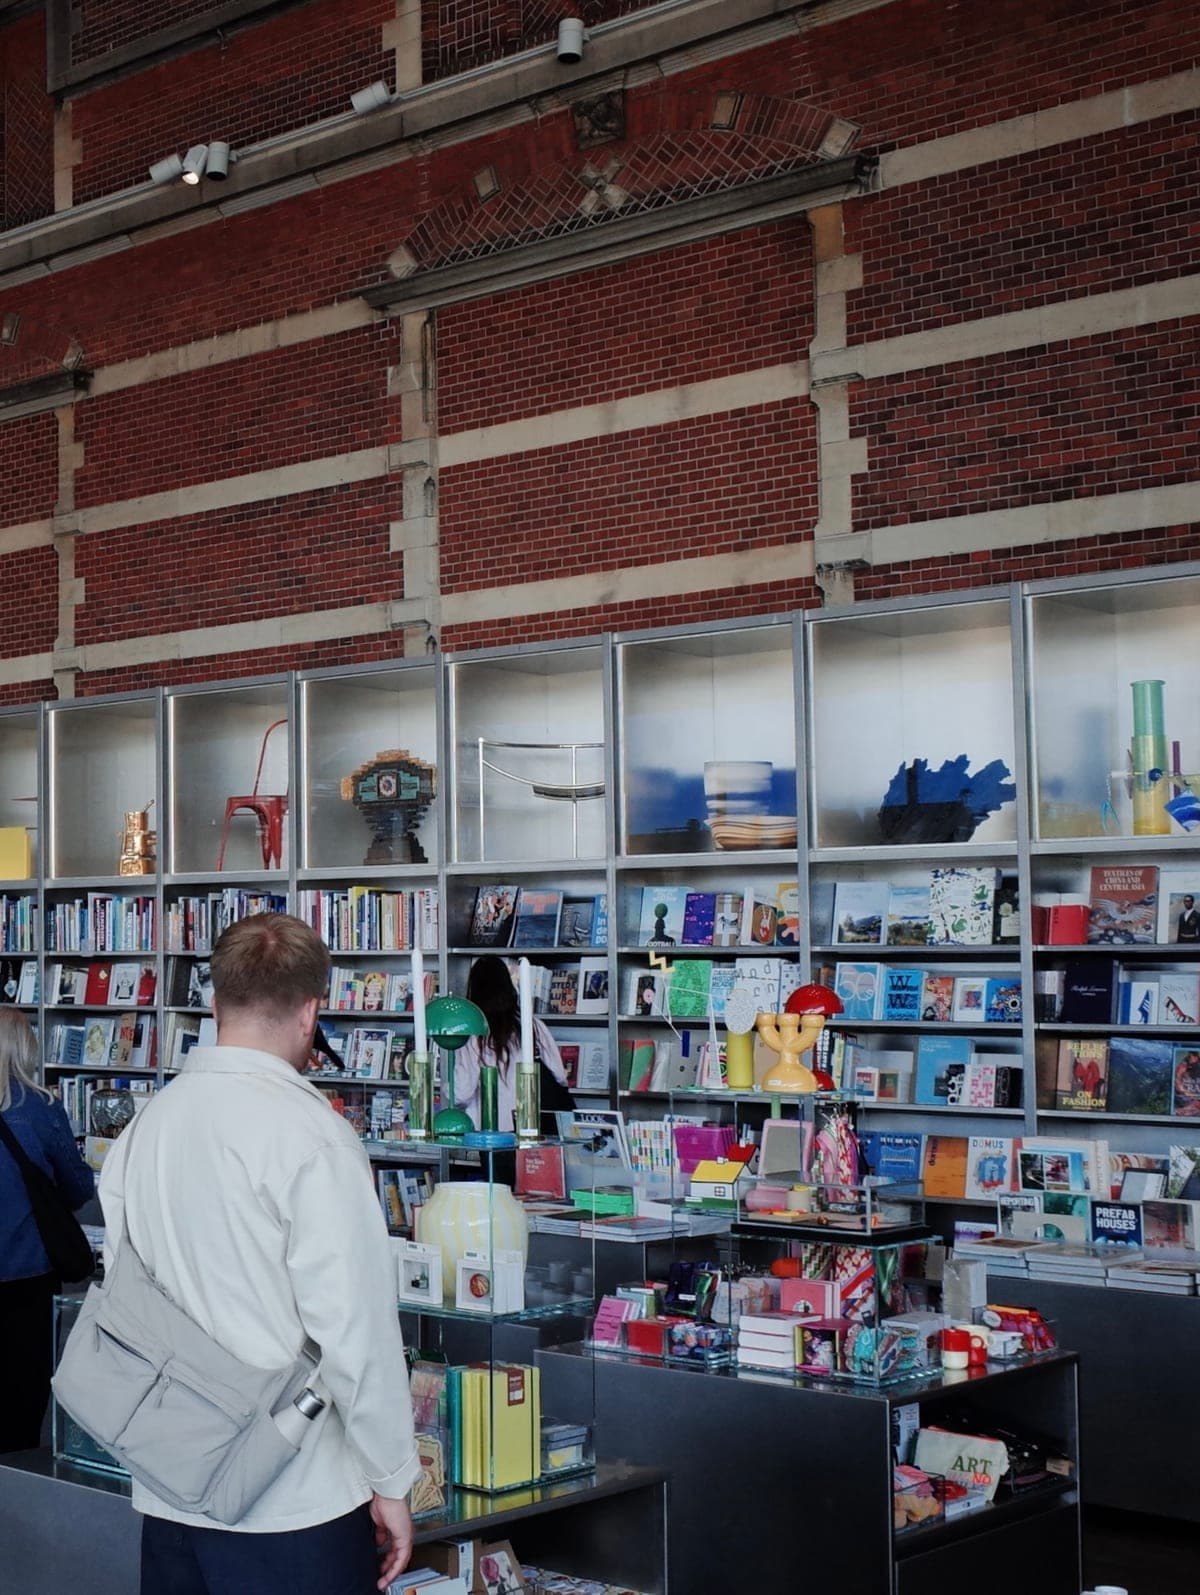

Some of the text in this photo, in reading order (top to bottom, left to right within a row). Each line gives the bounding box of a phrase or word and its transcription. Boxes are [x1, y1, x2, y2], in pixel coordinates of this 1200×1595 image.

[1062, 1097, 1106, 1107] FASHION
[972, 1139, 1004, 1149] DOMUS
[1095, 1206, 1136, 1220] PREFAB
[1095, 1218, 1137, 1231] HOUSES
[951, 1456, 992, 1474] ART
